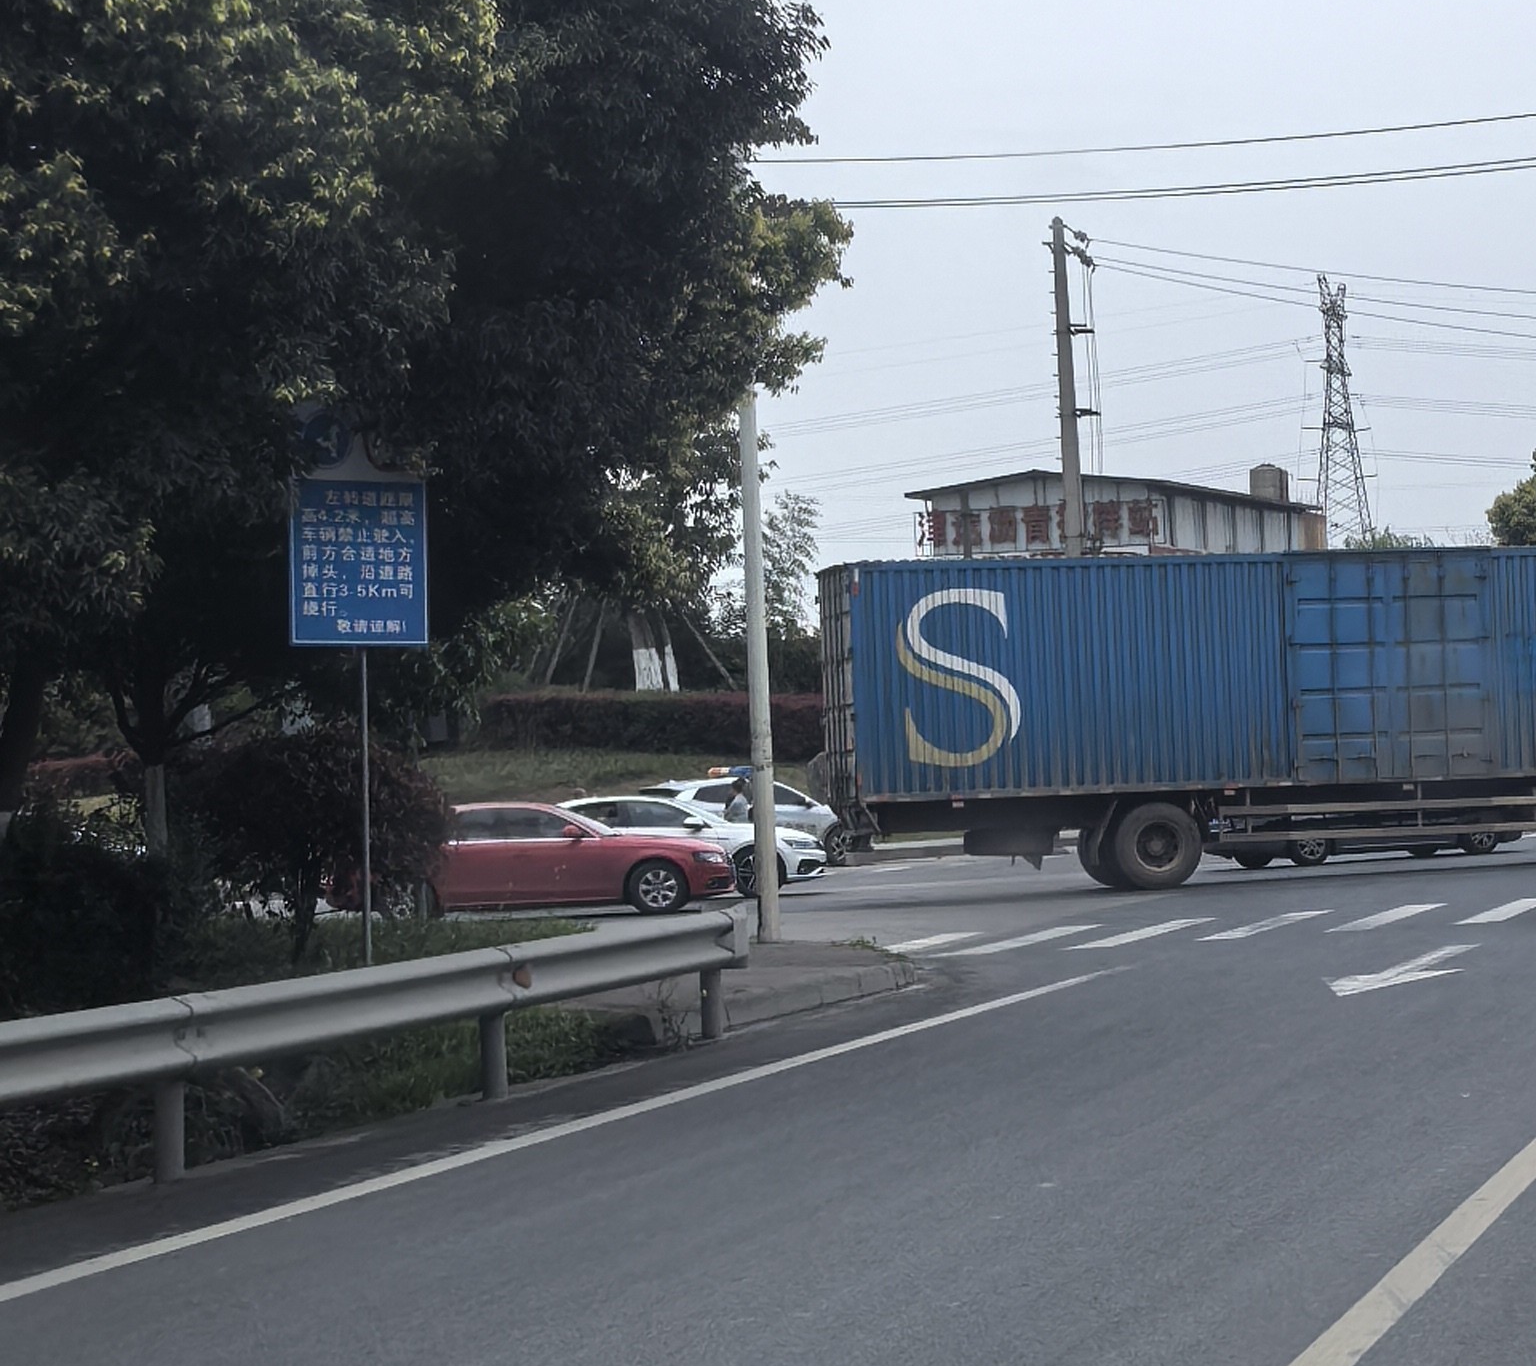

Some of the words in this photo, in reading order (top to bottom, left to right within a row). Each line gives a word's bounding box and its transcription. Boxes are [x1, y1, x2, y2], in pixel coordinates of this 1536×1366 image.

[302, 545, 414, 562] 前方合适地方
[896, 588, 1021, 767] S
